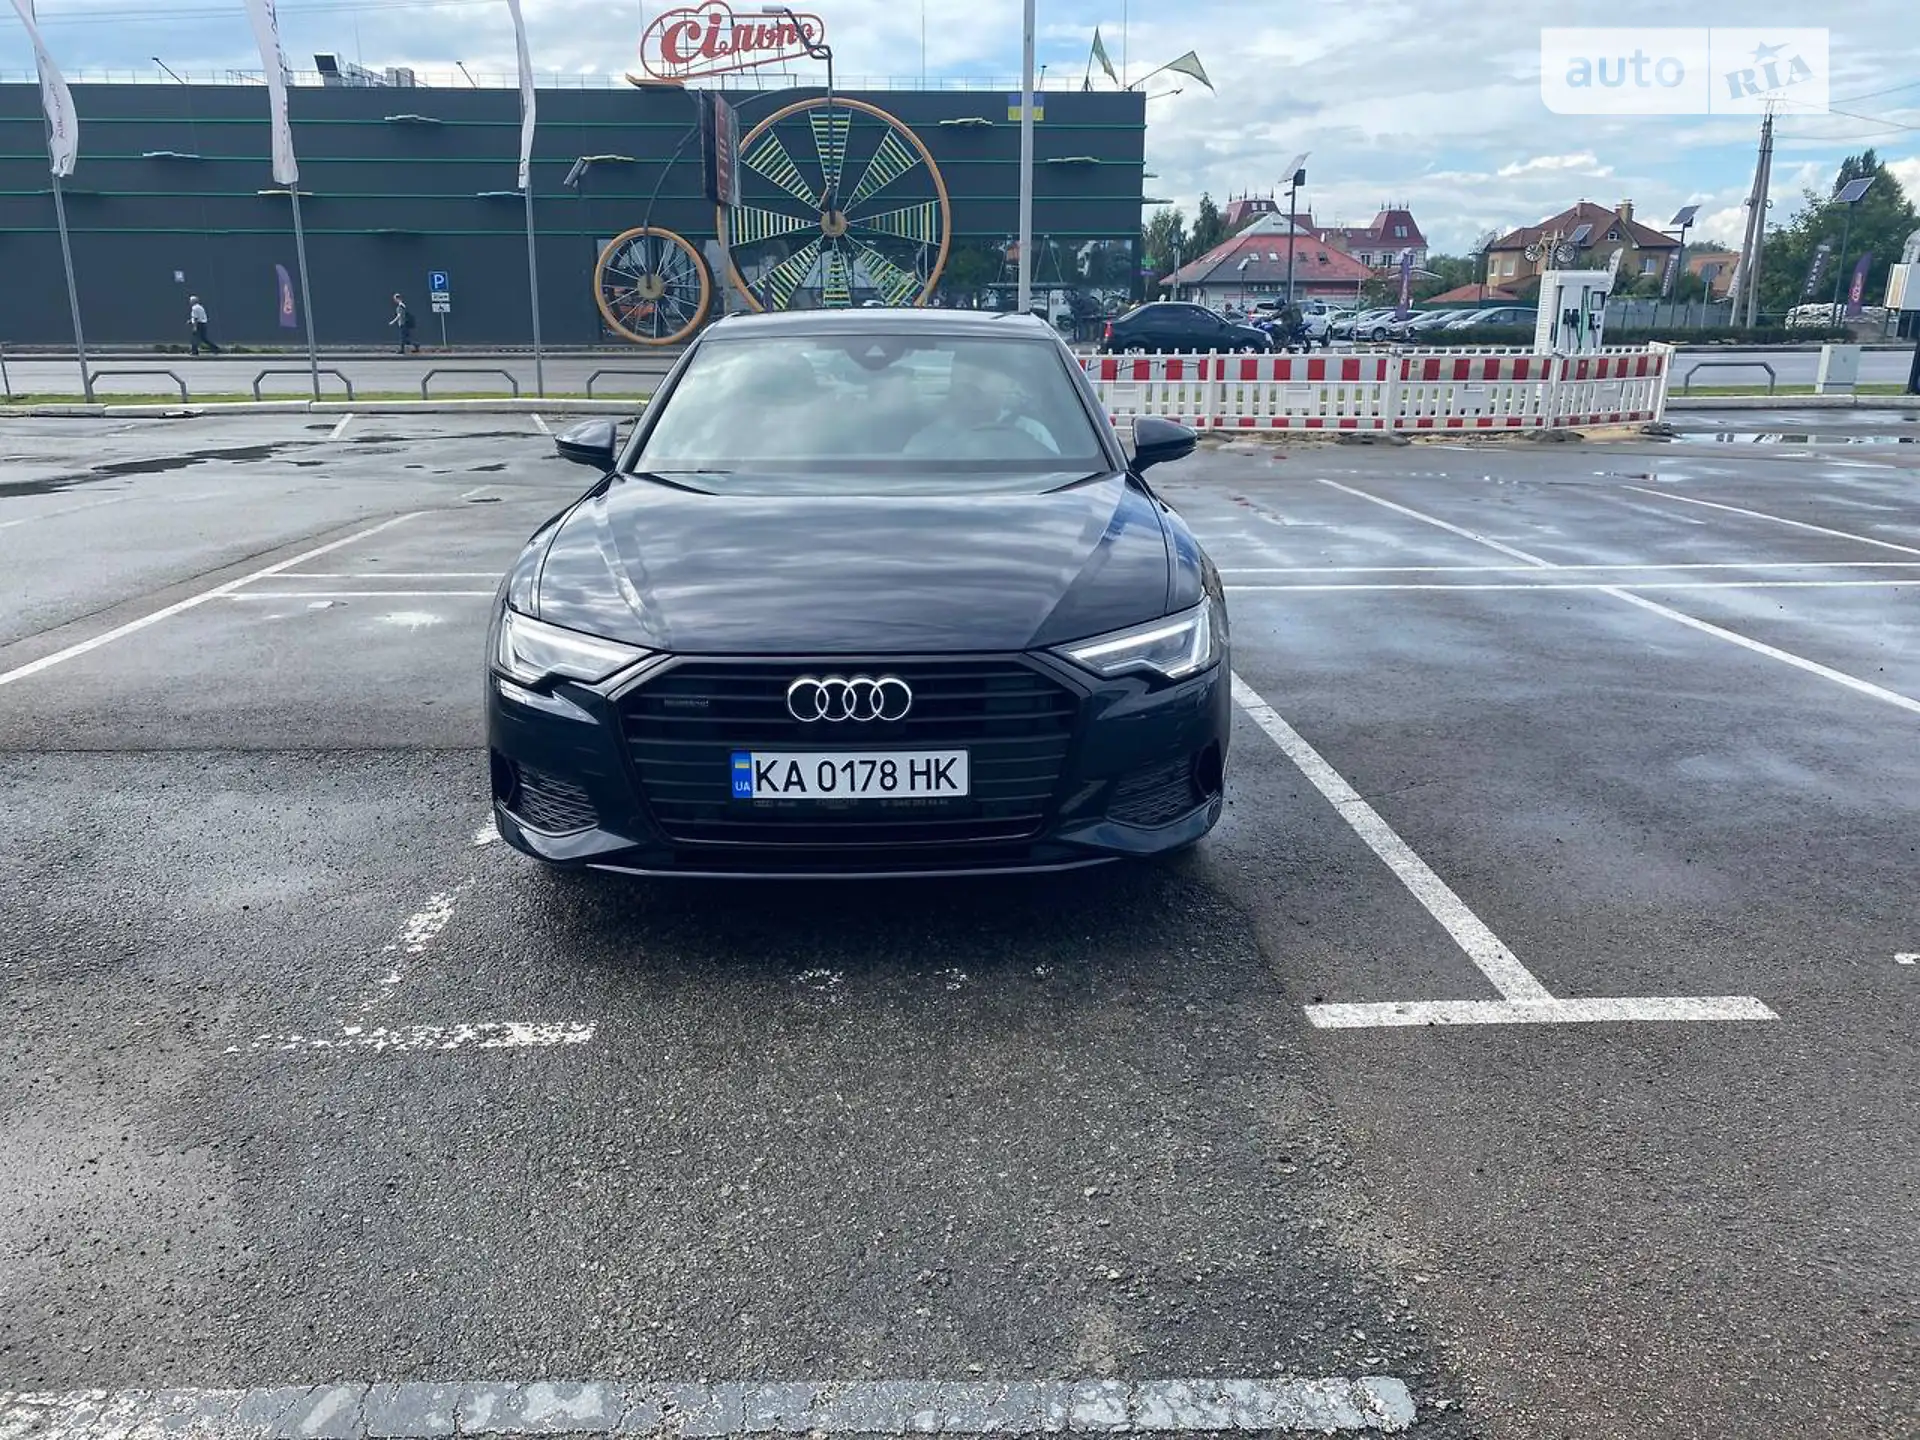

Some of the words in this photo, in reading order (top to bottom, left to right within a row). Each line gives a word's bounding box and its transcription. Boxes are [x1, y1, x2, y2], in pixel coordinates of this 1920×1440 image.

[434, 274, 445, 289] P
[734, 781, 751, 792] UA
[755, 759, 807, 793] KA
[817, 759, 898, 793] 0178
[909, 757, 958, 791] HK
